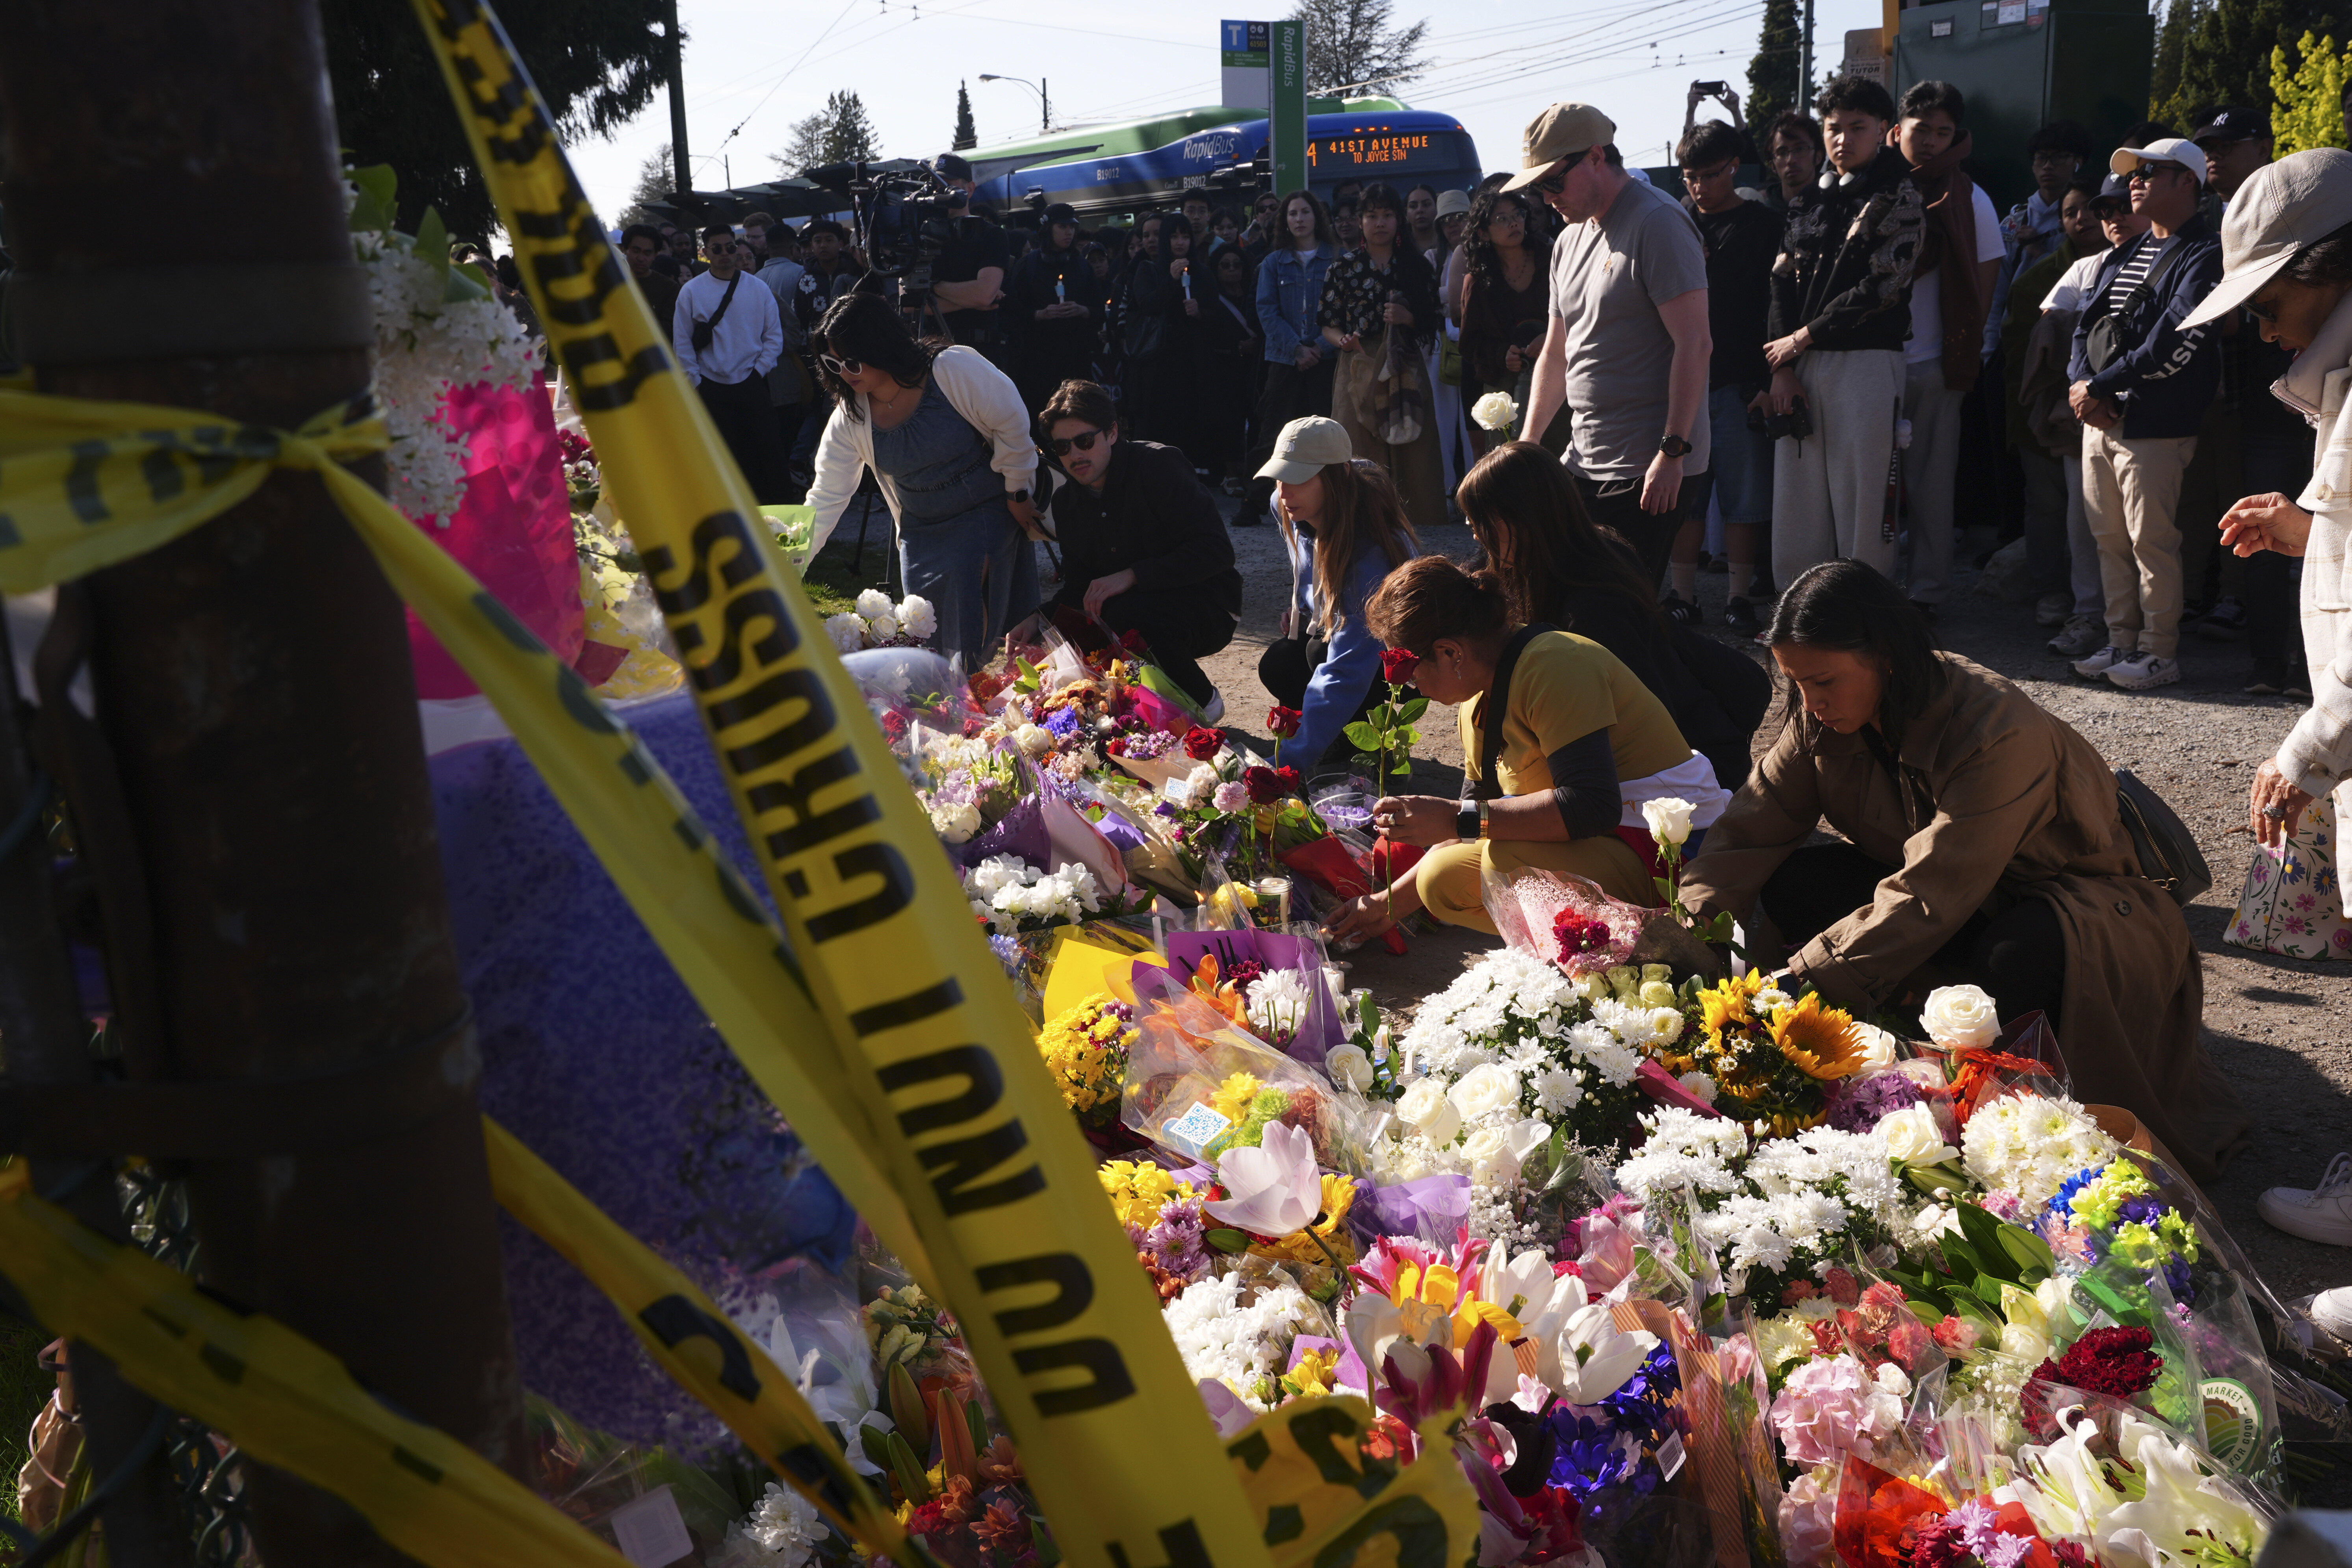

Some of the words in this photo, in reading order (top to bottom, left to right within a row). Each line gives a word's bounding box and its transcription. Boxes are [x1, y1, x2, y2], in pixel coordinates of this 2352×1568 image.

[1228, 25, 1242, 46] T
[1281, 26, 1296, 87] RapidBus
[1183, 135, 1235, 163] RapidBus
[1329, 140, 1365, 153] 41ST
[1372, 135, 1428, 150] AVENUE
[1353, 152, 1363, 163] TO
[1365, 150, 1390, 163] JOYCE
[1392, 149, 1407, 161] STN
[1097, 167, 1119, 180] B19012
[1183, 176, 1206, 189] B19012
[642, 510, 916, 943] CROSS
[2207, 1386, 2243, 1403] MARKET
[2229, 1447, 2246, 1466] FOR
[2242, 1418, 2254, 1445] GOOD
